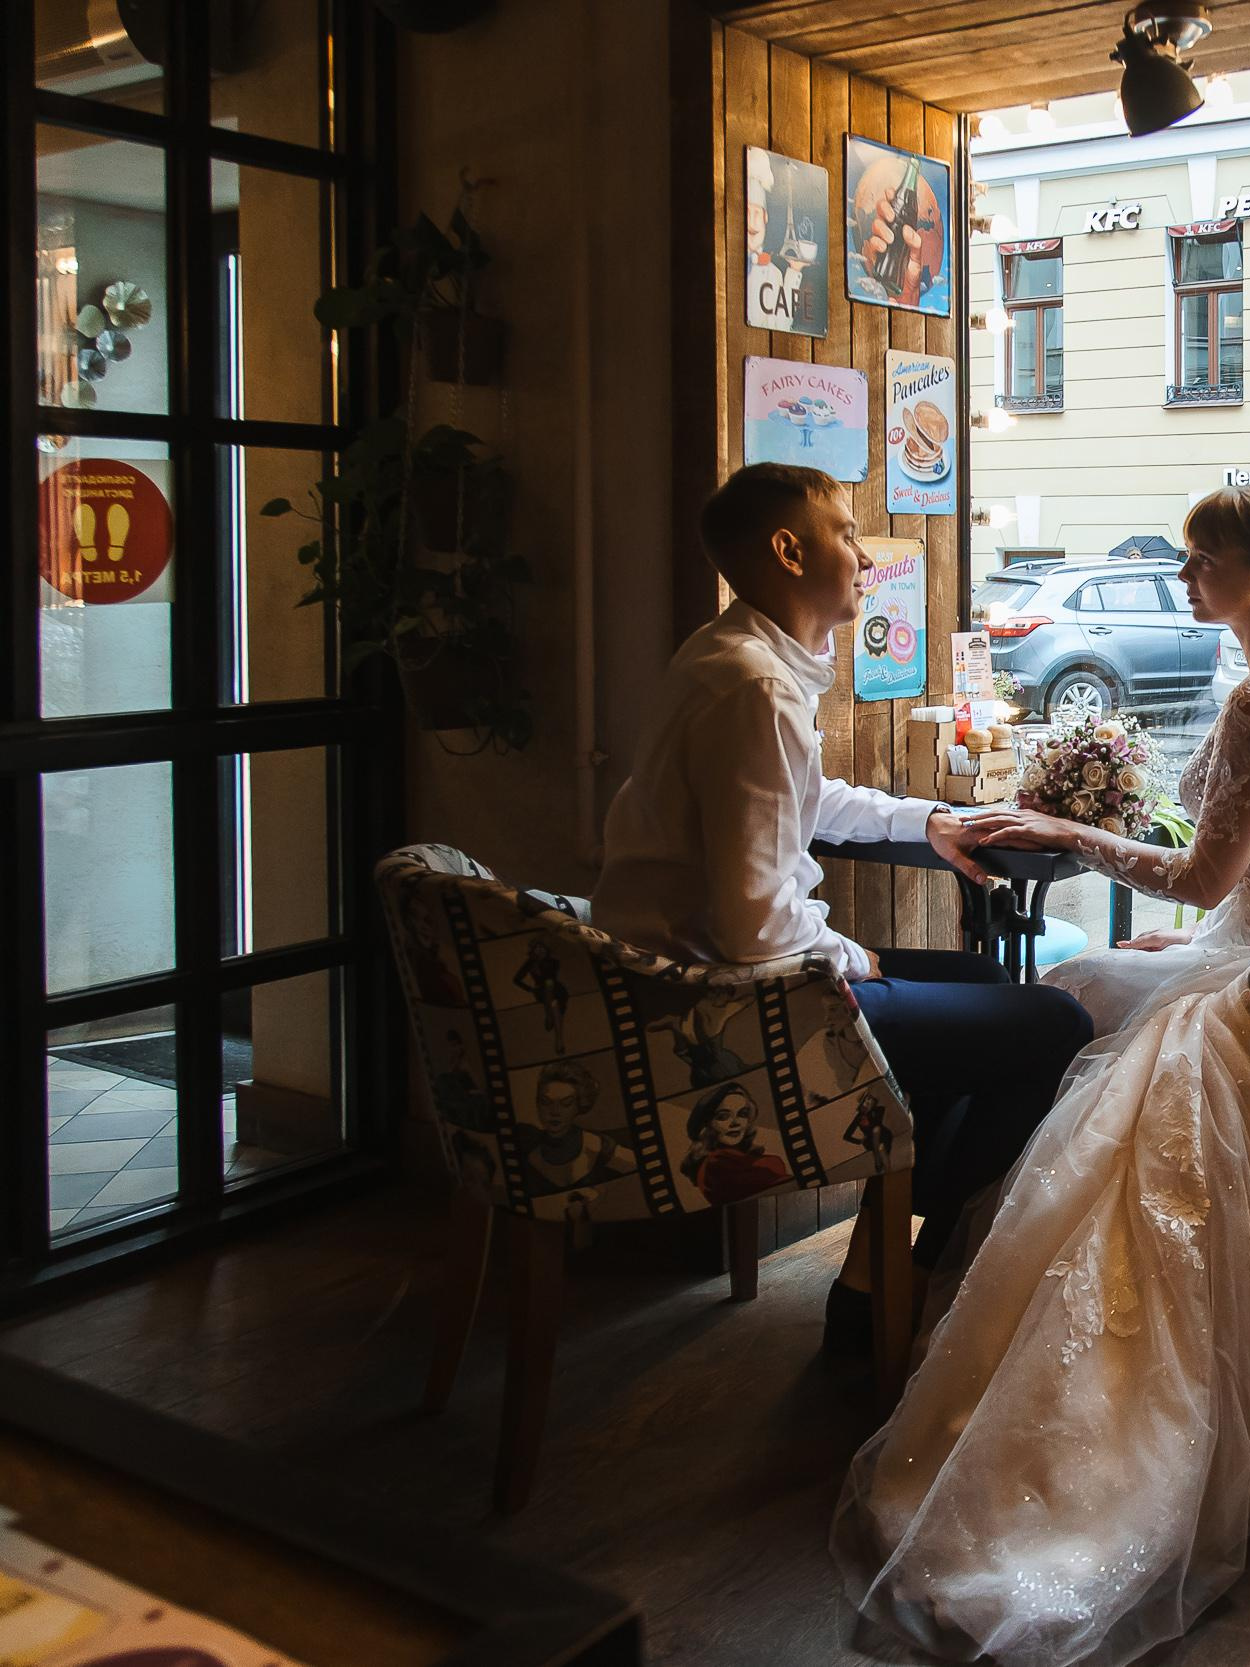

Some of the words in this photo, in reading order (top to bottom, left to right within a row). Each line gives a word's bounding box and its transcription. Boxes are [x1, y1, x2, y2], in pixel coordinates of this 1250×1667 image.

[1083, 204, 1142, 234] KFC
[1197, 223, 1221, 234] KFC
[1025, 240, 1046, 251] KFC
[892, 361, 930, 378] American
[893, 364, 950, 404] Pancakes
[761, 375, 804, 397] FAIRY
[807, 376, 853, 406] CAKES
[863, 554, 916, 589] Donuts
